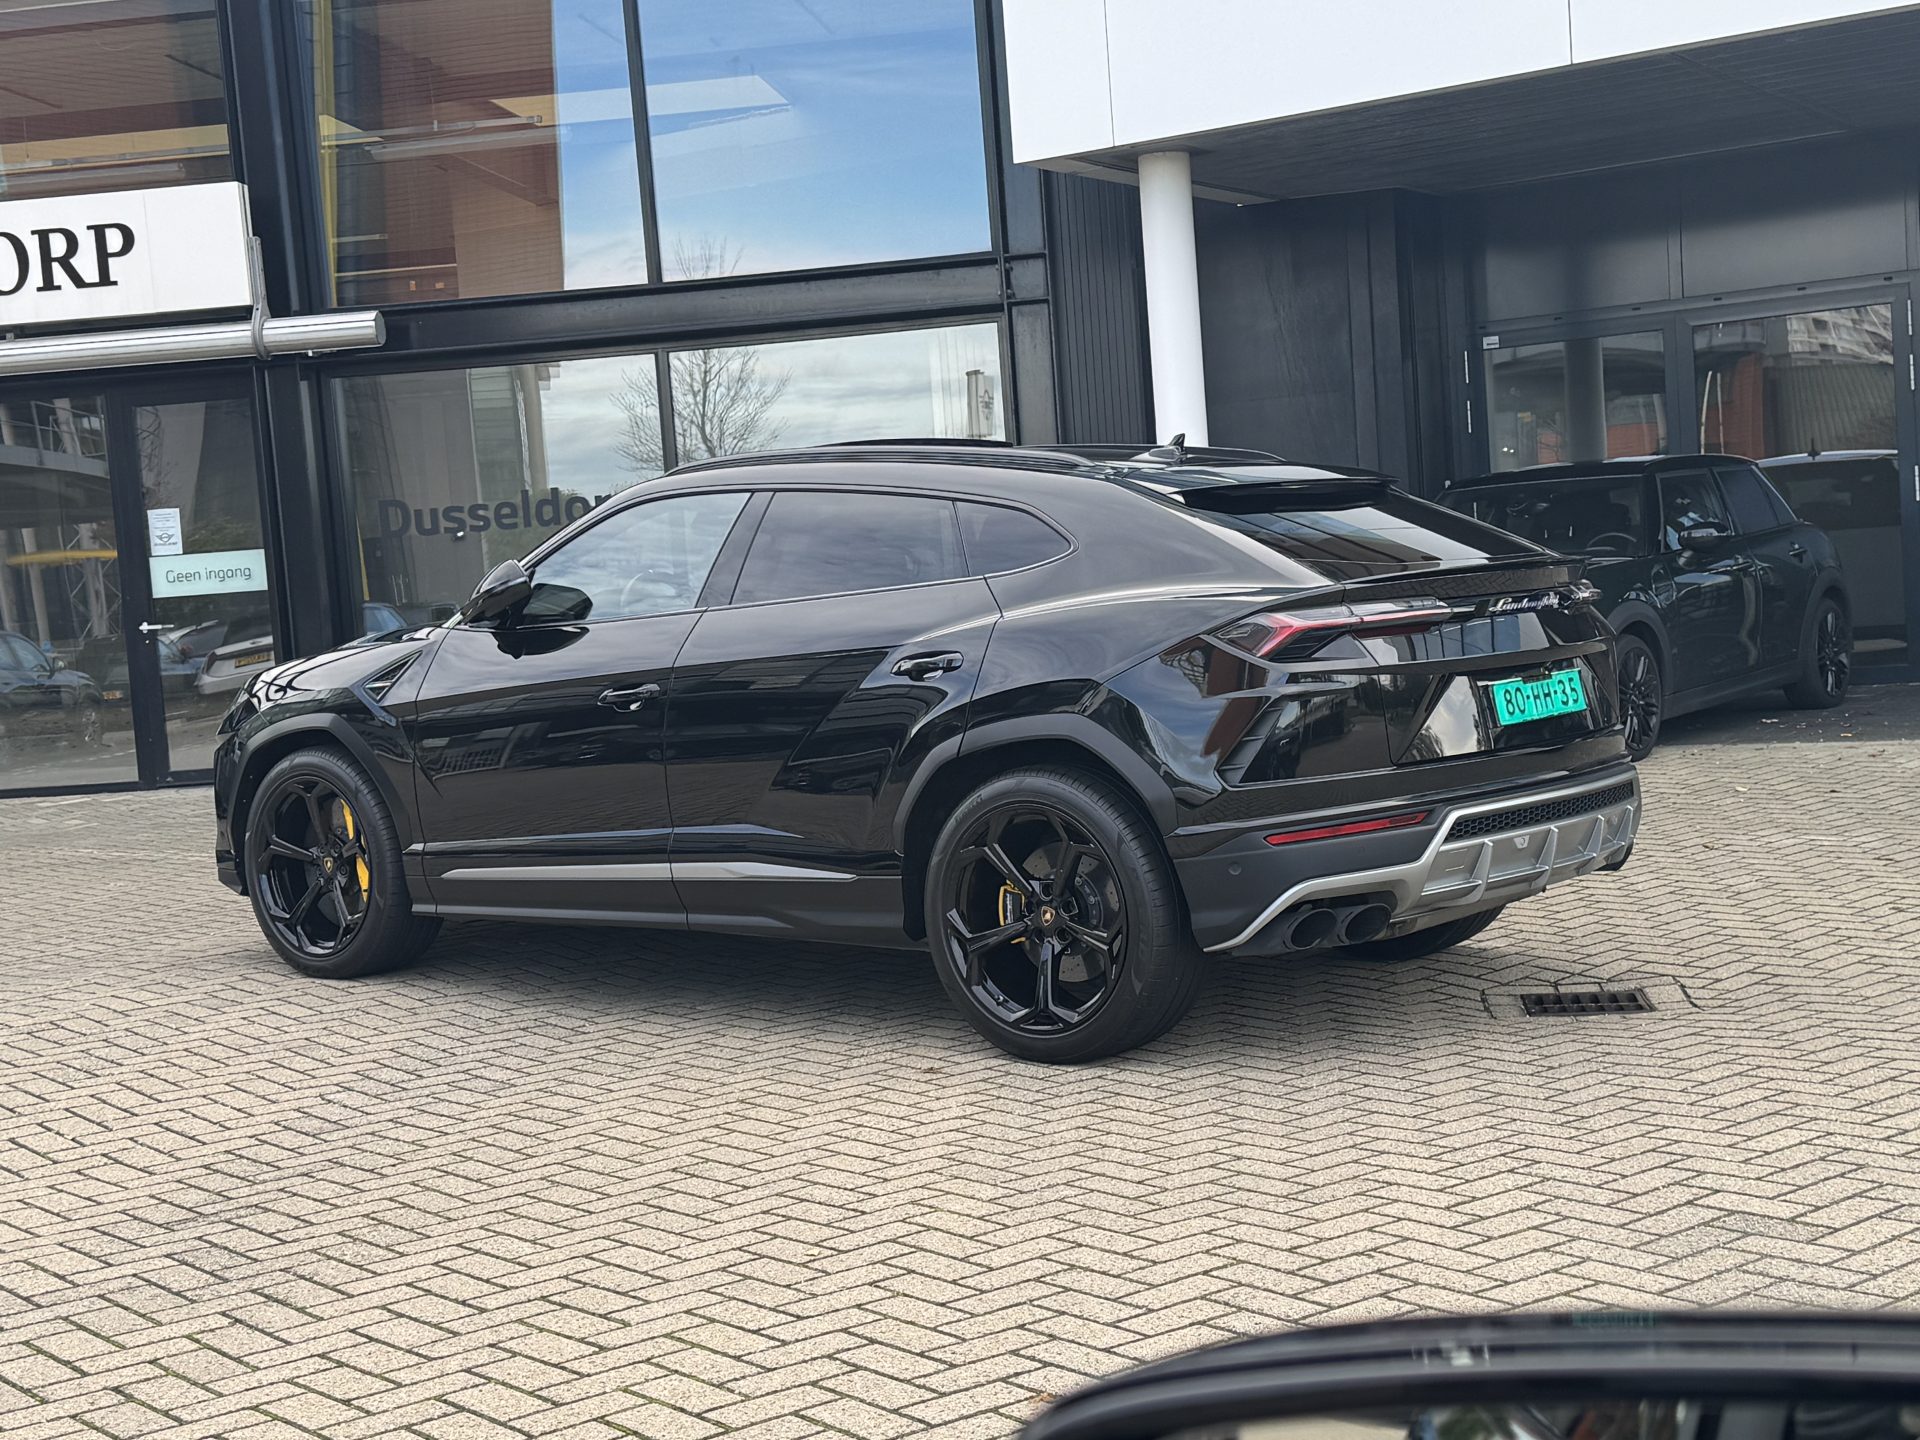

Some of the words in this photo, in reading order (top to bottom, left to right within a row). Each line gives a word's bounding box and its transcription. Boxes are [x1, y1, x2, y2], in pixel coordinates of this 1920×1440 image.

[165, 569, 201, 583] Geen
[205, 567, 252, 582] ingang
[1503, 677, 1579, 716] 80-HH-35
